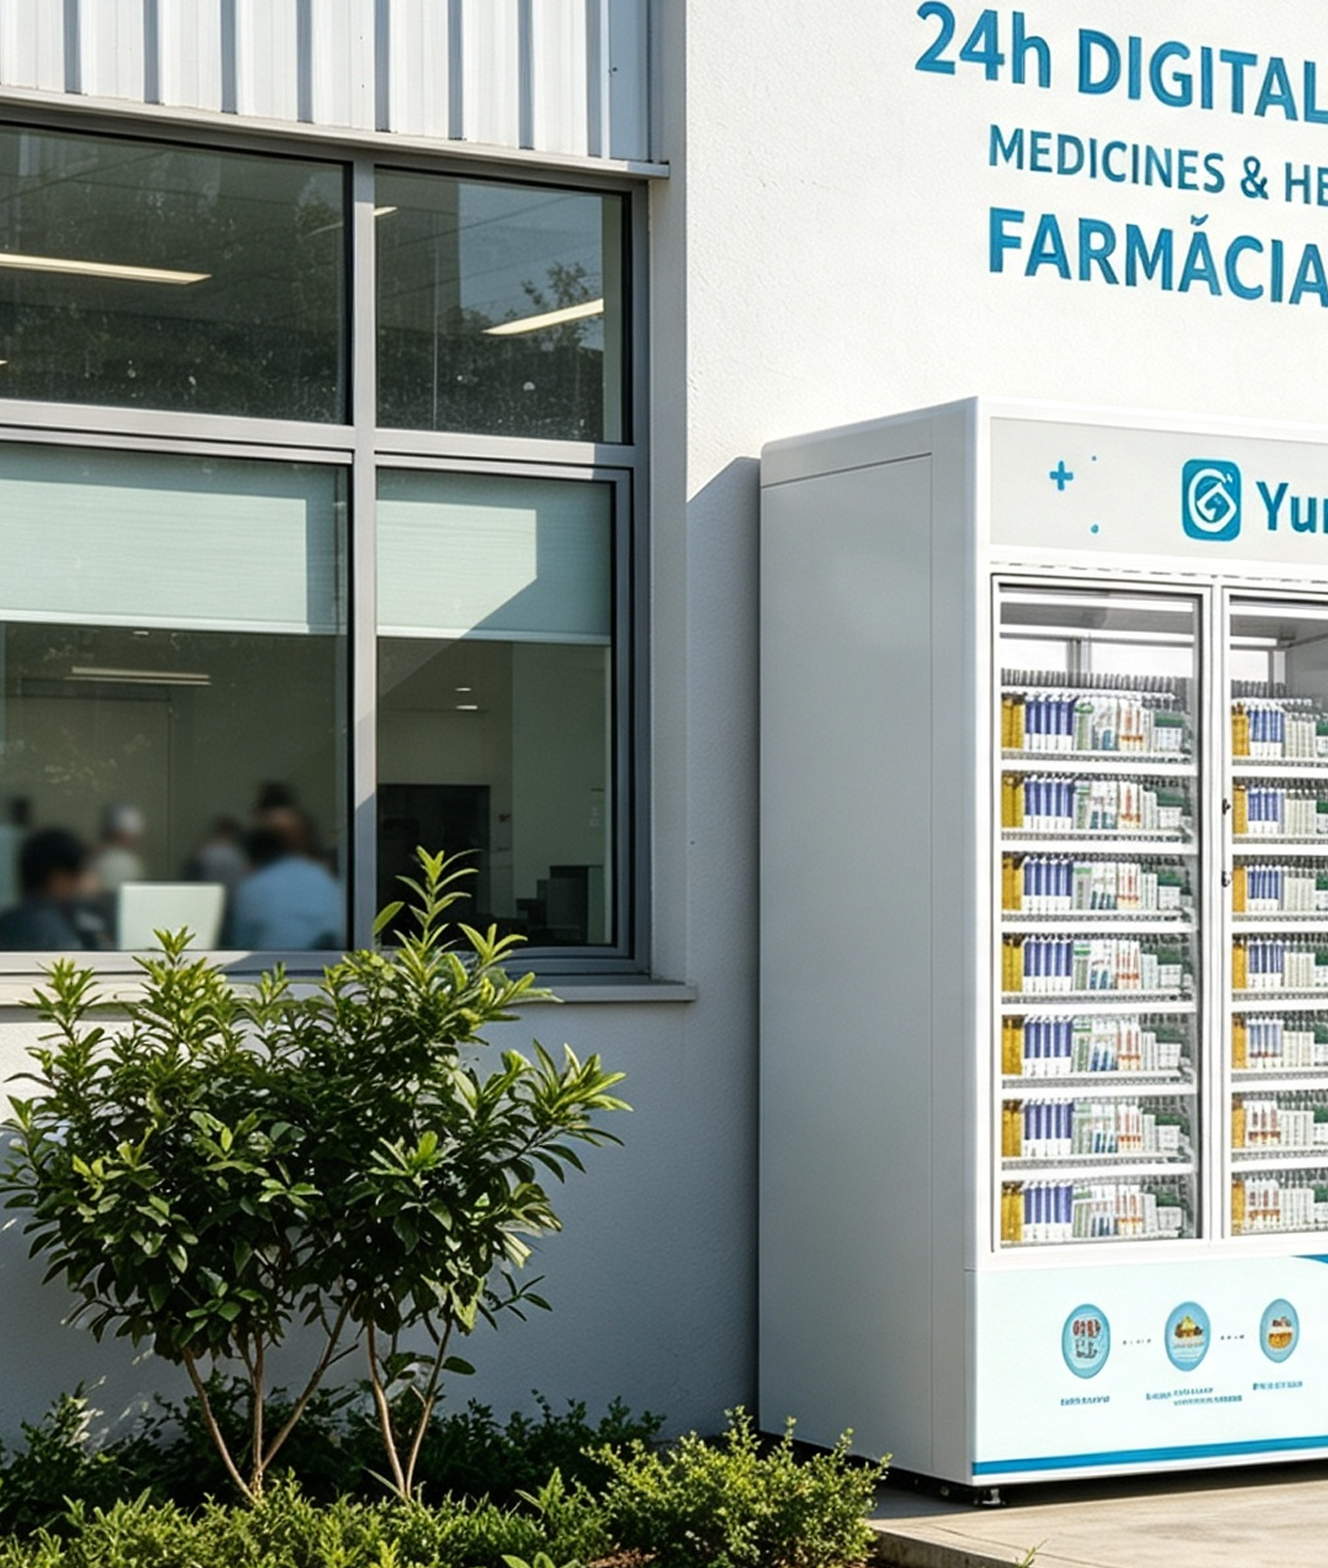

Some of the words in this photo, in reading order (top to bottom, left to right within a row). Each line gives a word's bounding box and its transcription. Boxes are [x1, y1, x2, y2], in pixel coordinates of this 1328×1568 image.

[914, 0, 1052, 89] 24h
[988, 124, 1226, 194] MEDICINES
[1239, 155, 1270, 201] &
